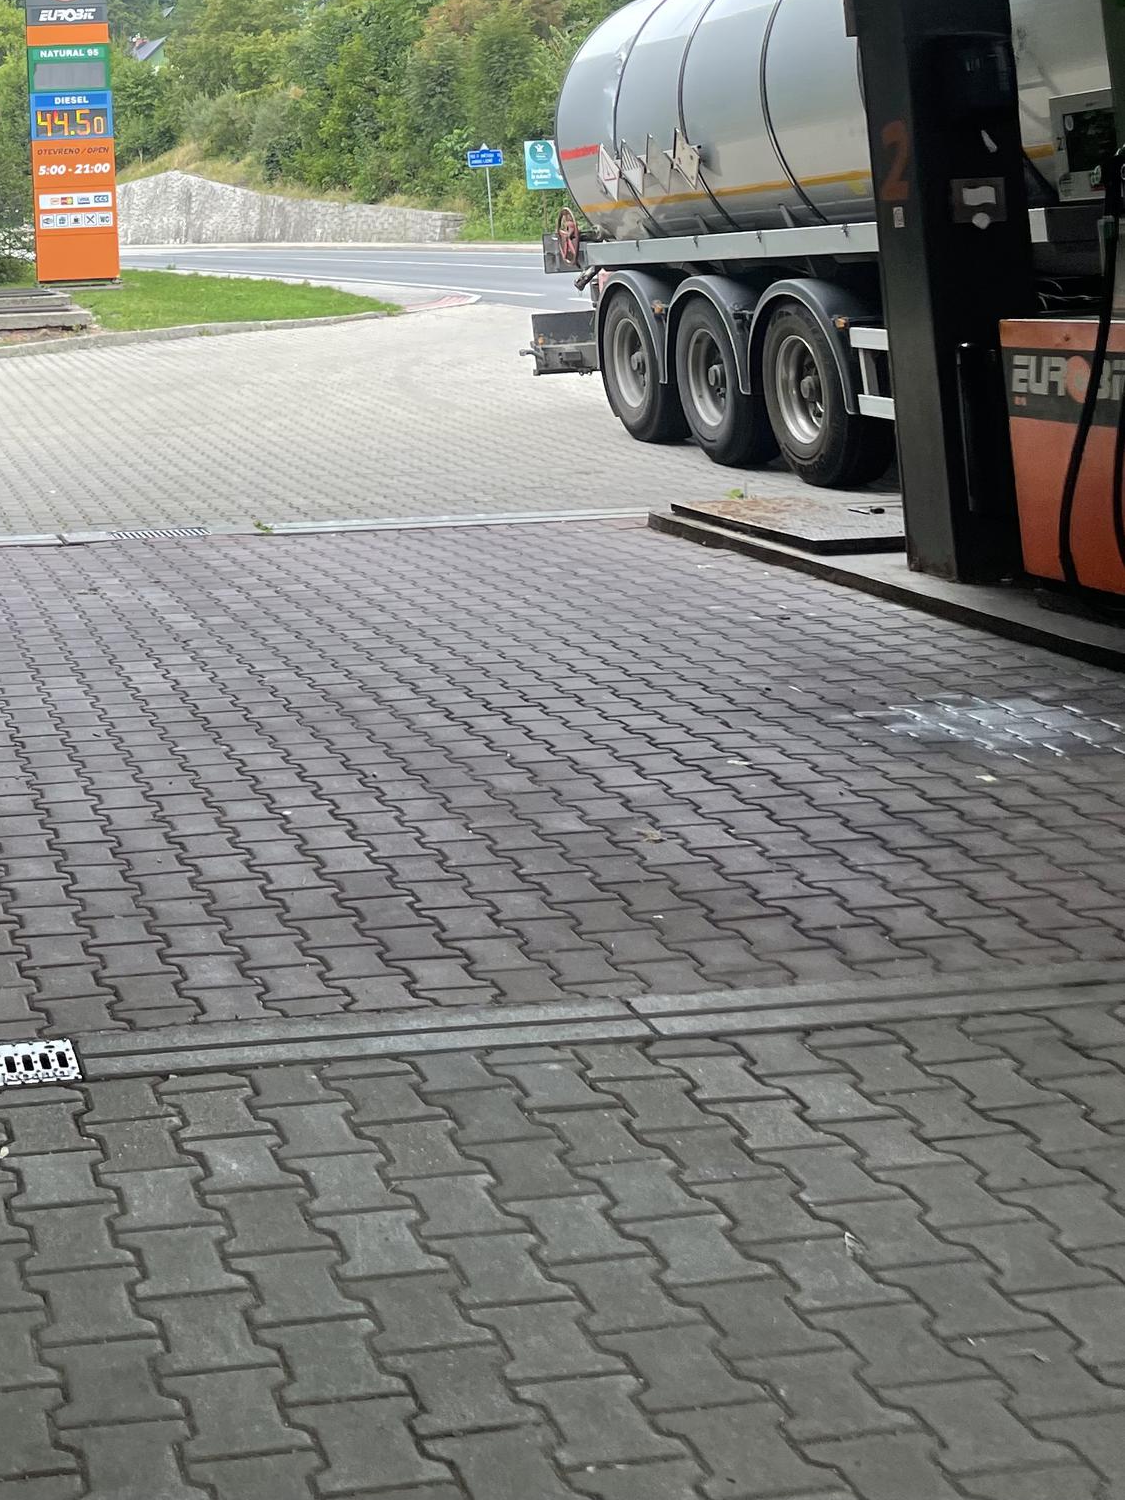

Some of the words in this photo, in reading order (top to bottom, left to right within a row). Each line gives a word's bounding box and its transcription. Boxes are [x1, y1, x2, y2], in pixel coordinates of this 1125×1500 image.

[39, 49, 85, 57] NATURAL
[54, 96, 89, 104] DIESEL
[36, 109, 104, 137] 44.50
[881, 120, 909, 201] 2
[38, 165, 66, 175] 5:00
[74, 163, 110, 174] 21:00
